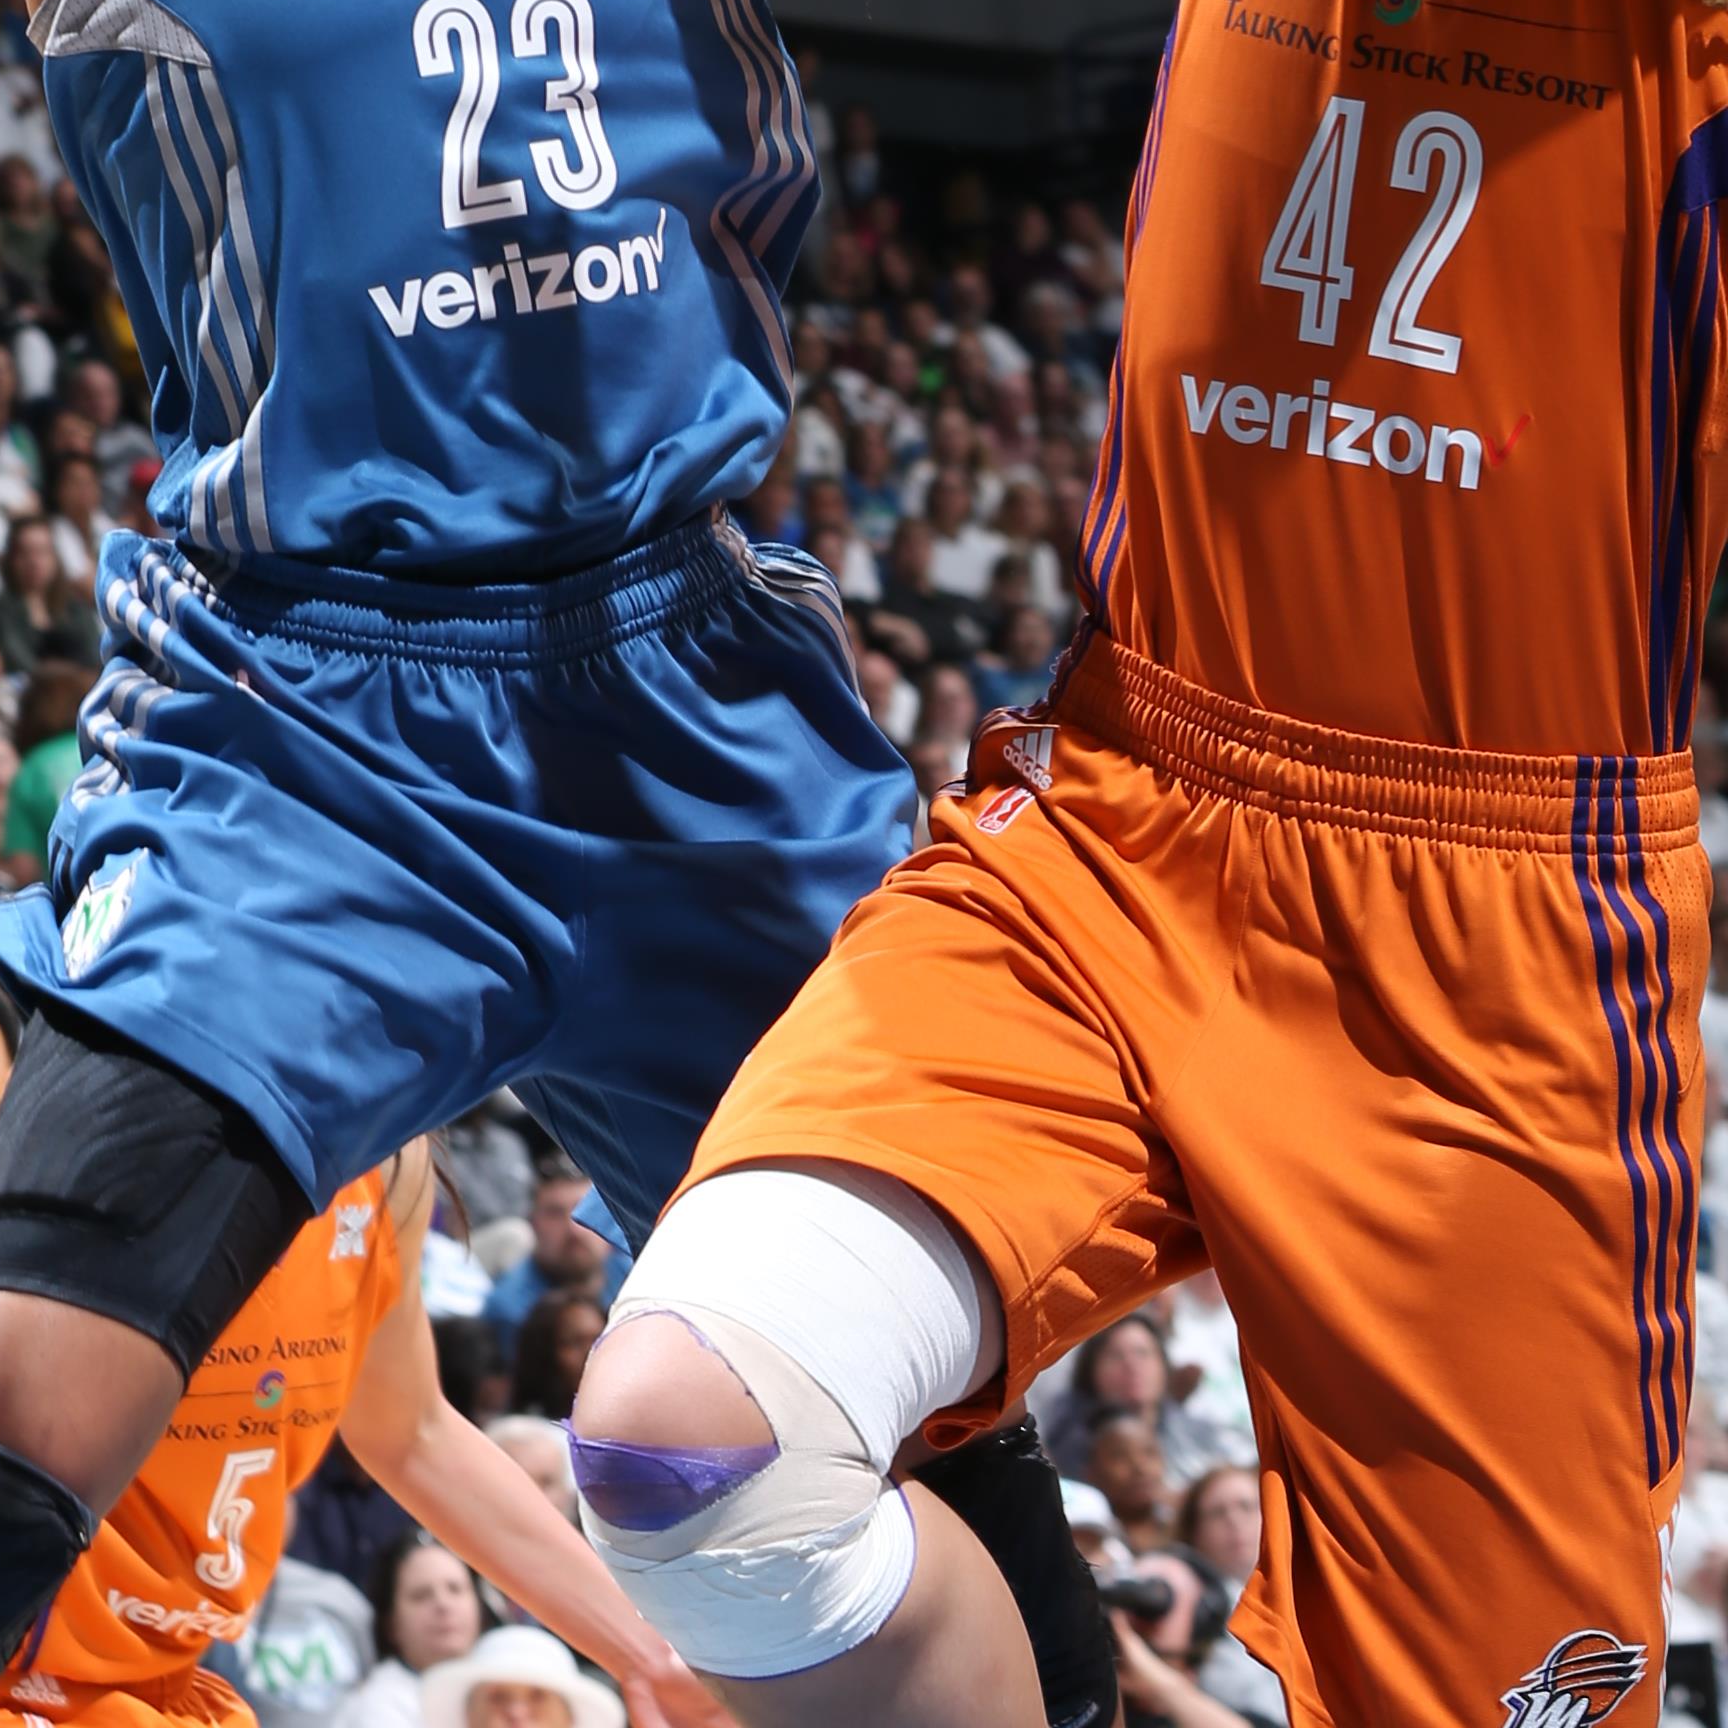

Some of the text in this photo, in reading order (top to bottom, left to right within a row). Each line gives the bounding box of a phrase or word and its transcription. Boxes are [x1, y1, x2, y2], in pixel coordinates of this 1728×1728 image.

[1350, 34, 1452, 85] STICK
[1460, 50, 1614, 112] RESORT
[367, 235, 660, 338] verizon
[1260, 96, 1484, 374] 42
[1180, 373, 1484, 491] verizon
[202, 1343, 261, 1368] SINO
[194, 1447, 277, 1590] 5
